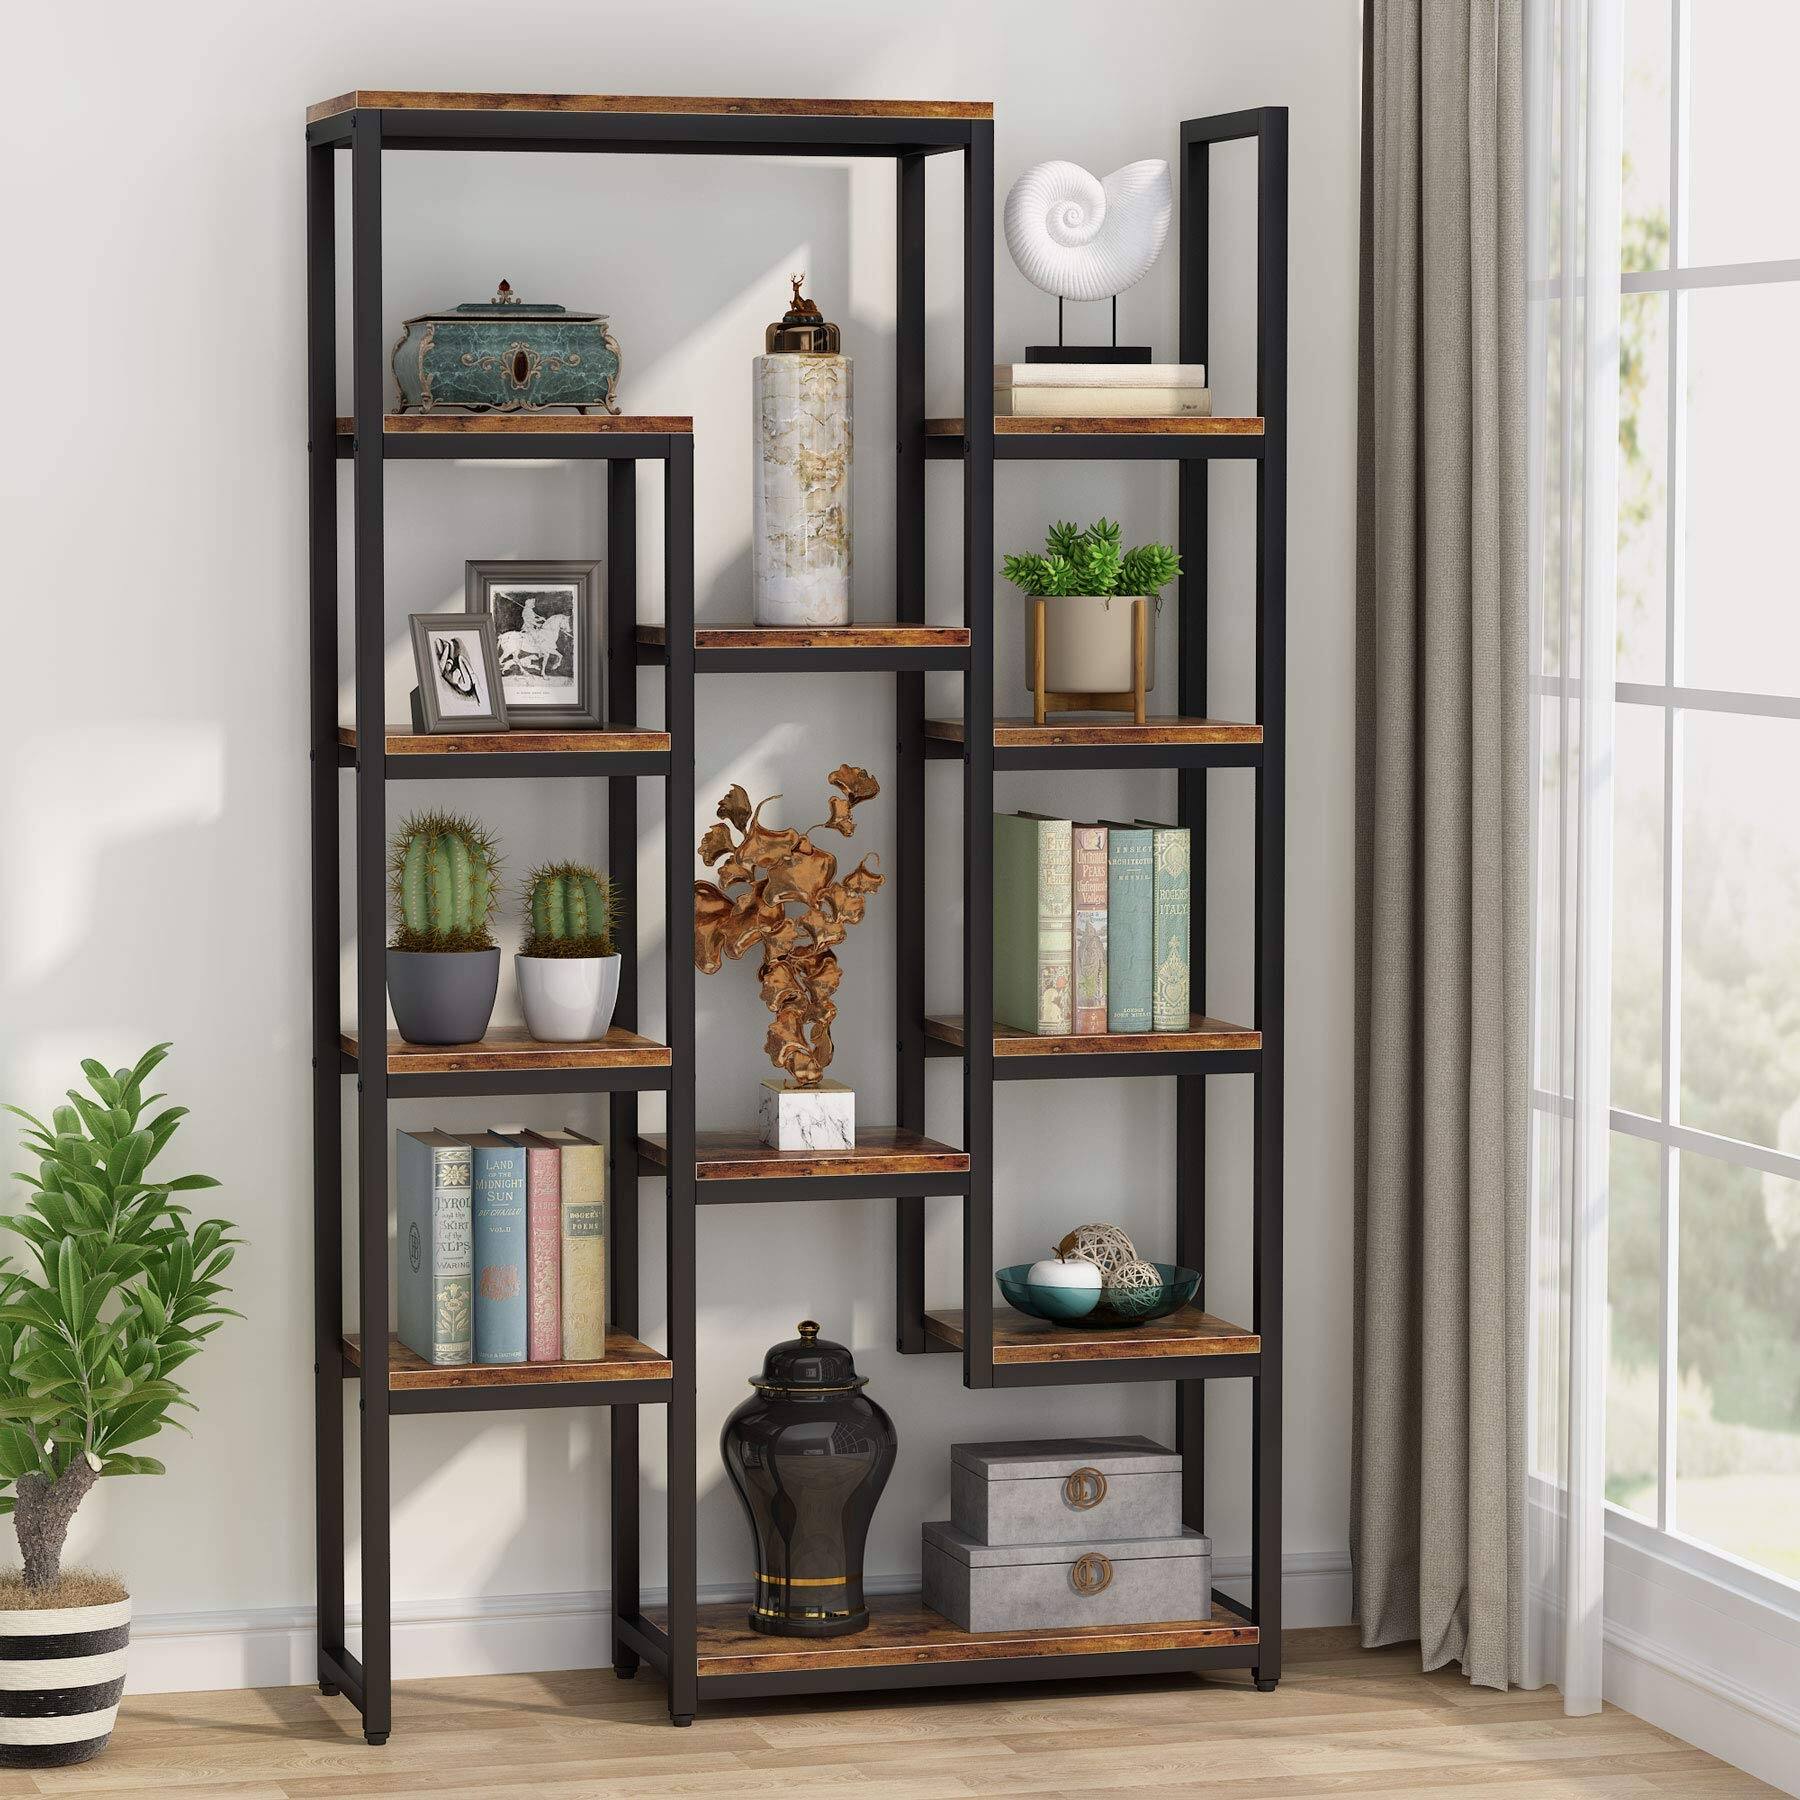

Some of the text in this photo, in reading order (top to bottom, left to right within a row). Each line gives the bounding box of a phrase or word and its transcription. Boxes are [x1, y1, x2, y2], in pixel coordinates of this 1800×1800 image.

[486, 1160, 514, 1170] LAND
[475, 1179, 523, 1190] MIDNIGHT
[487, 1191, 513, 1202] SUN
[436, 1260, 471, 1269] WARING
